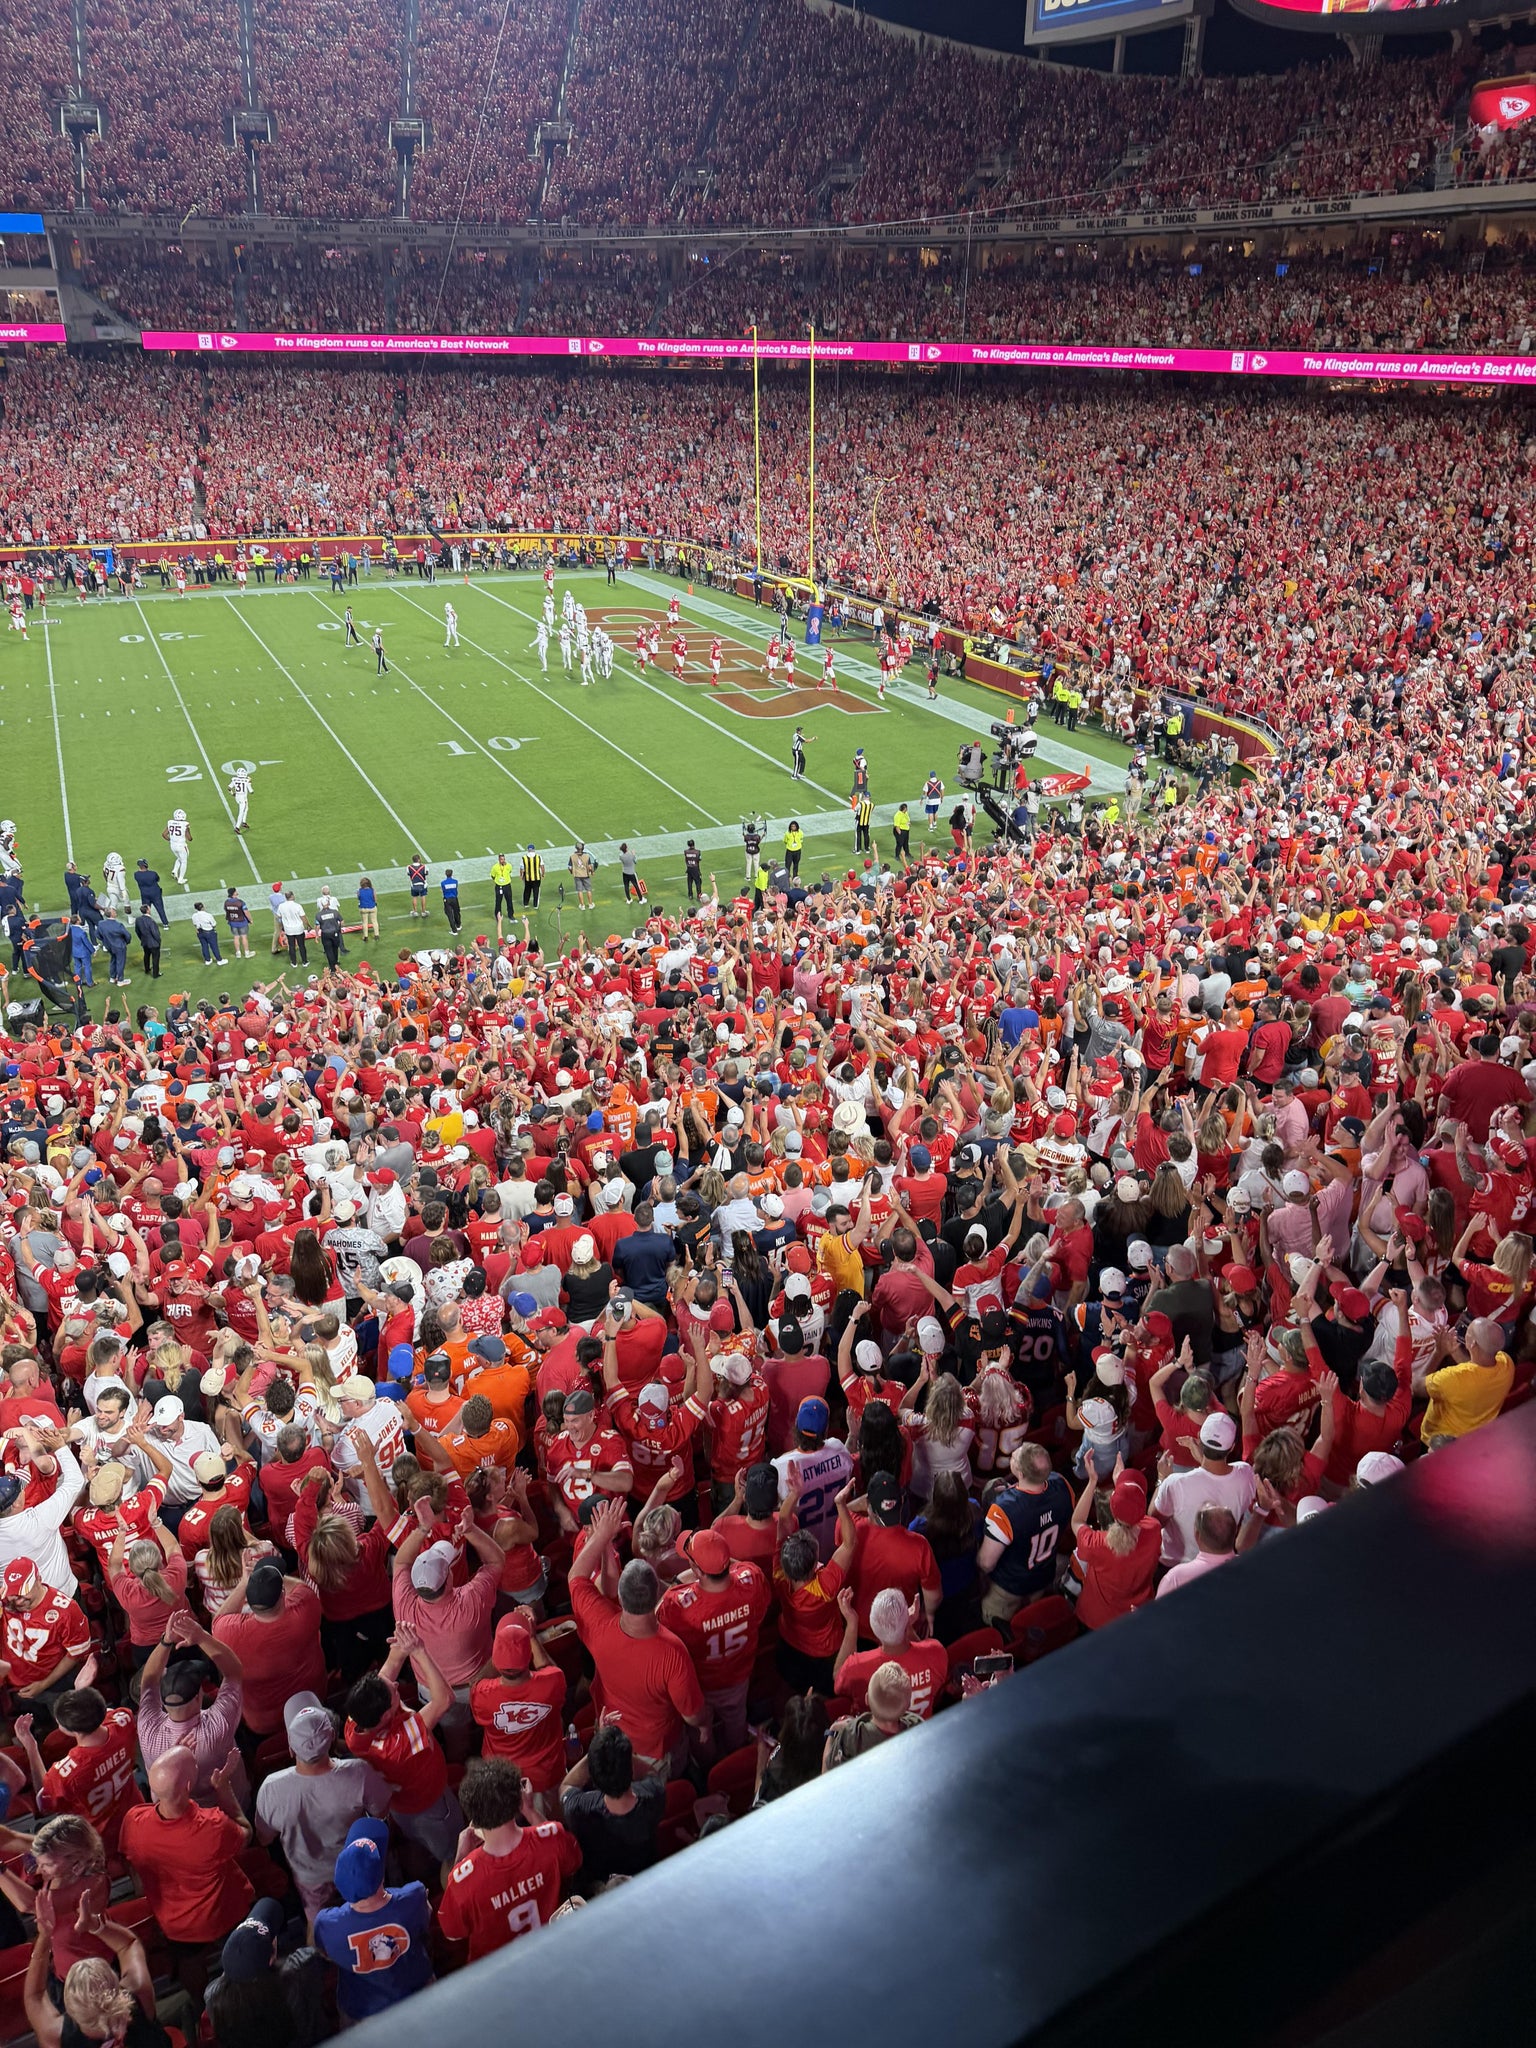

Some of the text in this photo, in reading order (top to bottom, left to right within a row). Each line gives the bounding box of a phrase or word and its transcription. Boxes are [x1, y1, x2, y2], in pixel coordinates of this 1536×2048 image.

[1213, 207, 1273, 222] HANK STRAM
[1291, 201, 1352, 215] 44 J. WILSON
[94, 217, 121, 227] HUNT
[229, 221, 256, 231] MAYS
[1033, 221, 1061, 232] BUDDE
[1097, 218, 1128, 229] LANIER
[1161, 213, 1197, 225] THOMAS
[380, 225, 428, 235] ROBINSON
[467, 228, 510, 237] BURFORD
[548, 228, 579, 238] HOLUB
[885, 226, 931, 237] BUCHANAN
[273, 337, 510, 350] The Kingdom runs on America's Best Network
[637, 342, 854, 355] The Kingdom runs on America's Best Network
[971, 349, 1175, 365] The Kingdom runs on America's Best Network
[1303, 357, 1323, 370] The
[1323, 358, 1374, 373] Kingdom
[1375, 361, 1401, 373] runs
[1403, 362, 1418, 374] on
[1419, 361, 1480, 375] America's
[1482, 362, 1512, 376] Best
[235, 782, 245, 793] 31
[169, 825, 182, 837] 95
[1184, 878, 1194, 891] 15
[641, 976, 654, 989] 15
[609, 1120, 632, 1141] 15
[1039, 1147, 1076, 1164] WIEGMANN
[480, 1231, 498, 1241] MAHO
[775, 1234, 786, 1247] NIX
[327, 1239, 362, 1250] MAHOMES
[336, 1252, 360, 1271] 15
[814, 1289, 831, 1304] OMES
[1133, 1284, 1152, 1299] SHA
[804, 1329, 818, 1342] TAIN
[1018, 1334, 1055, 1363] 20
[339, 1347, 355, 1368] KELCE
[463, 1355, 477, 1369] NIX
[1297, 1388, 1321, 1404] HOLM
[378, 1416, 398, 1441] JONES
[424, 1417, 438, 1428] NIX
[379, 1429, 406, 1470] 95
[641, 1439, 662, 1450] ELCE
[978, 1422, 1028, 1471] 15
[481, 1453, 496, 1467] NIX
[802, 1454, 842, 1482] ATWATER
[799, 1477, 847, 1530] 27
[184, 1507, 207, 1526] 87
[1039, 1509, 1054, 1528] NIX
[94, 1522, 137, 1541] MAHOES
[1028, 1523, 1059, 1570] 10
[702, 1604, 751, 1633] MAHOMES
[6, 1617, 50, 1663] 87
[705, 1621, 749, 1661] 15
[911, 1669, 932, 1688] MES
[505, 1707, 540, 1725] KC
[93, 1748, 126, 1782] JONES
[88, 1758, 132, 1817] 95
[452, 1859, 475, 1884] 9
[490, 1871, 545, 1912] WALKER
[507, 1898, 542, 1935] 9
[347, 1922, 411, 1975] D
